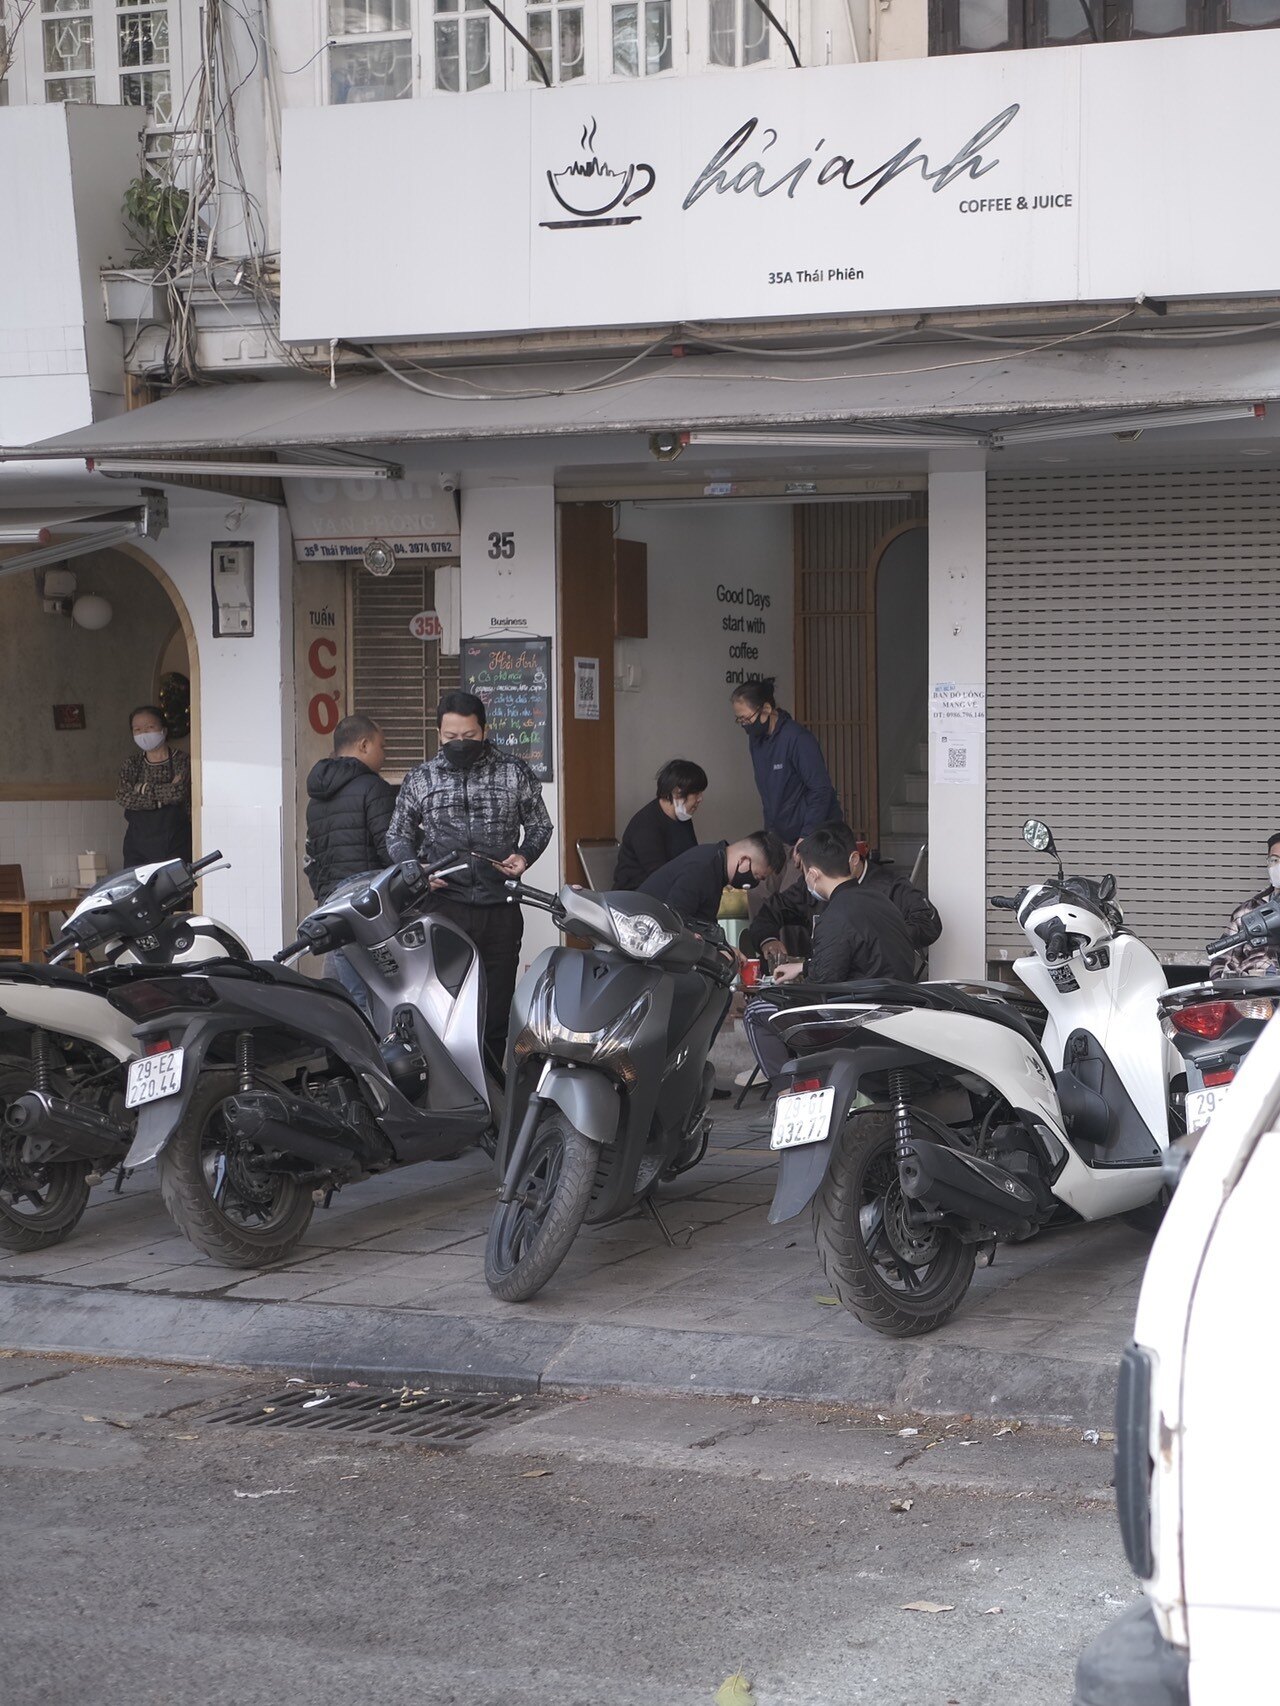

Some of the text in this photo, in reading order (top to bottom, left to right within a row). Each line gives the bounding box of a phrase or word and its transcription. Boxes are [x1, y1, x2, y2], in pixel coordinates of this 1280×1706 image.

[959, 193, 1073, 213] COFFEE & JUICE
[768, 267, 864, 284] 35A Thái Phiên
[488, 531, 515, 560] 35
[716, 584, 771, 611] Good Days
[309, 605, 335, 626] TUẤN
[490, 617, 527, 626] Business
[722, 614, 766, 635] start with
[728, 641, 759, 660] coffee
[725, 667, 744, 684] and
[136, 1053, 175, 1082] 29-E2
[130, 1072, 177, 1104] 220.44
